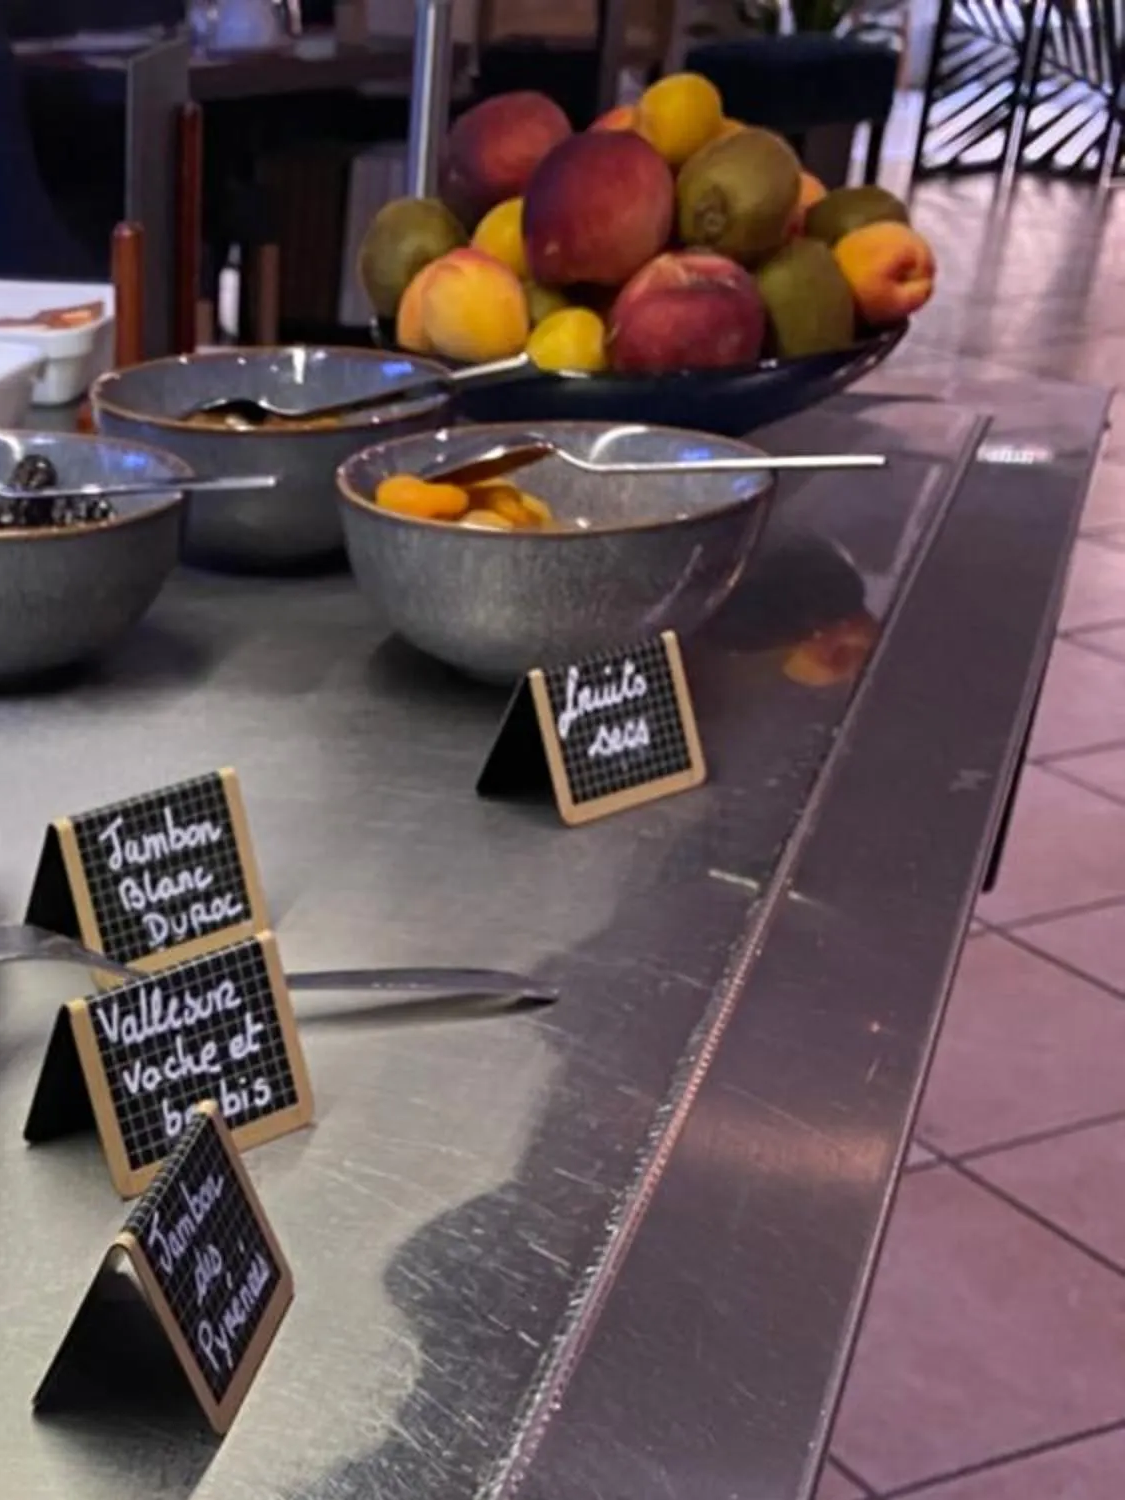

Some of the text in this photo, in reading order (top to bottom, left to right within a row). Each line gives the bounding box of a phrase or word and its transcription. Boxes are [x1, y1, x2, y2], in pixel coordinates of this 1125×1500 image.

[98, 806, 221, 871] Jambon
[118, 865, 213, 911] Blanc
[229, 1012, 264, 1060] et
[147, 1174, 224, 1274] Jambon
